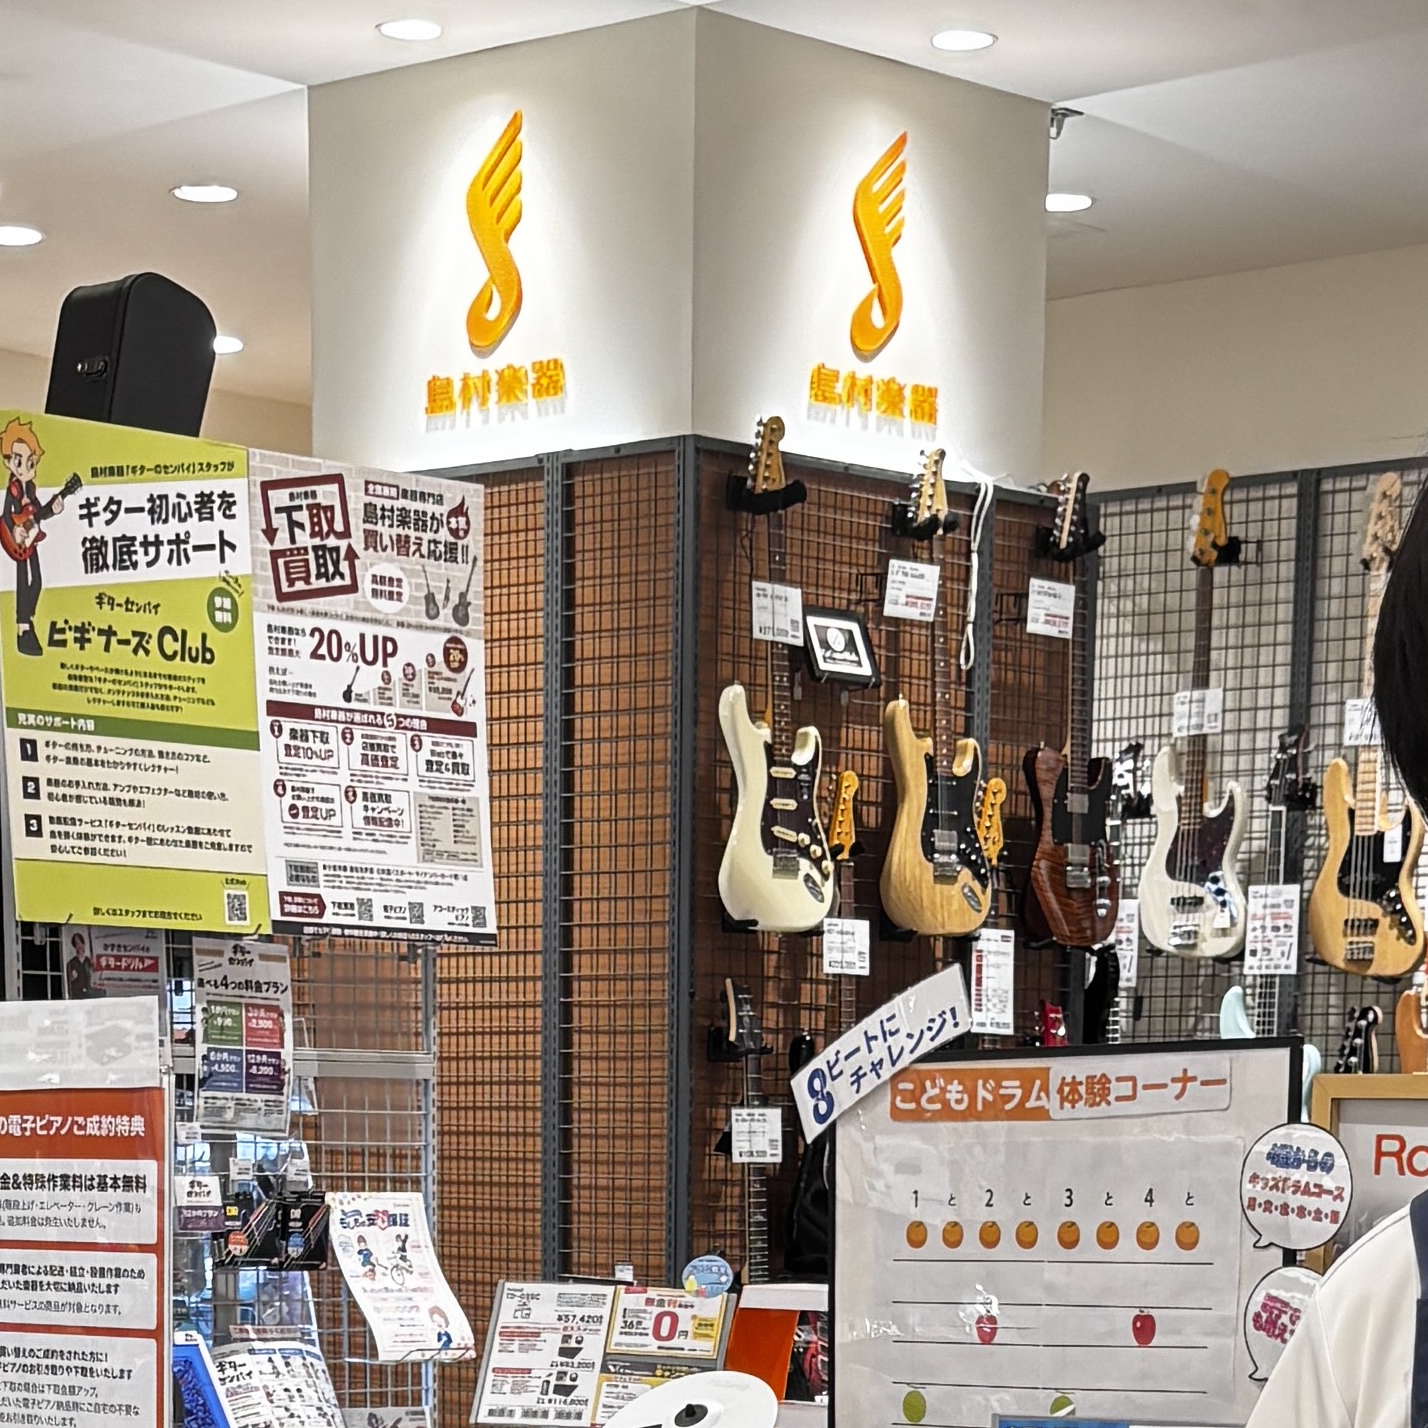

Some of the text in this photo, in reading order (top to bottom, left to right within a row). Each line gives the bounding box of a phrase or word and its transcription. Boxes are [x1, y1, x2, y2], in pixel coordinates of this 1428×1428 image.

[425, 358, 567, 418] 島村楽器
[809, 362, 939, 425] 島村楽器
[78, 490, 237, 528] ギター初心者を
[274, 502, 342, 546] 下取
[362, 501, 444, 535] 島村楽器が
[81, 529, 237, 575] 徹底サポート
[283, 543, 346, 589] 買取
[94, 591, 162, 616] ギターセンパイ
[47, 618, 216, 666] ビギナーズ Club
[308, 626, 399, 669] 20%UP
[806, 1067, 835, 1126] 8
[825, 1011, 901, 1082] ビートに
[848, 1005, 961, 1094] チャレンジ!
[893, 1068, 1228, 1112] こどもドラム 体験コーナー
[912, 1188, 1195, 1207] 1 と 2 と 3 と 4 と
